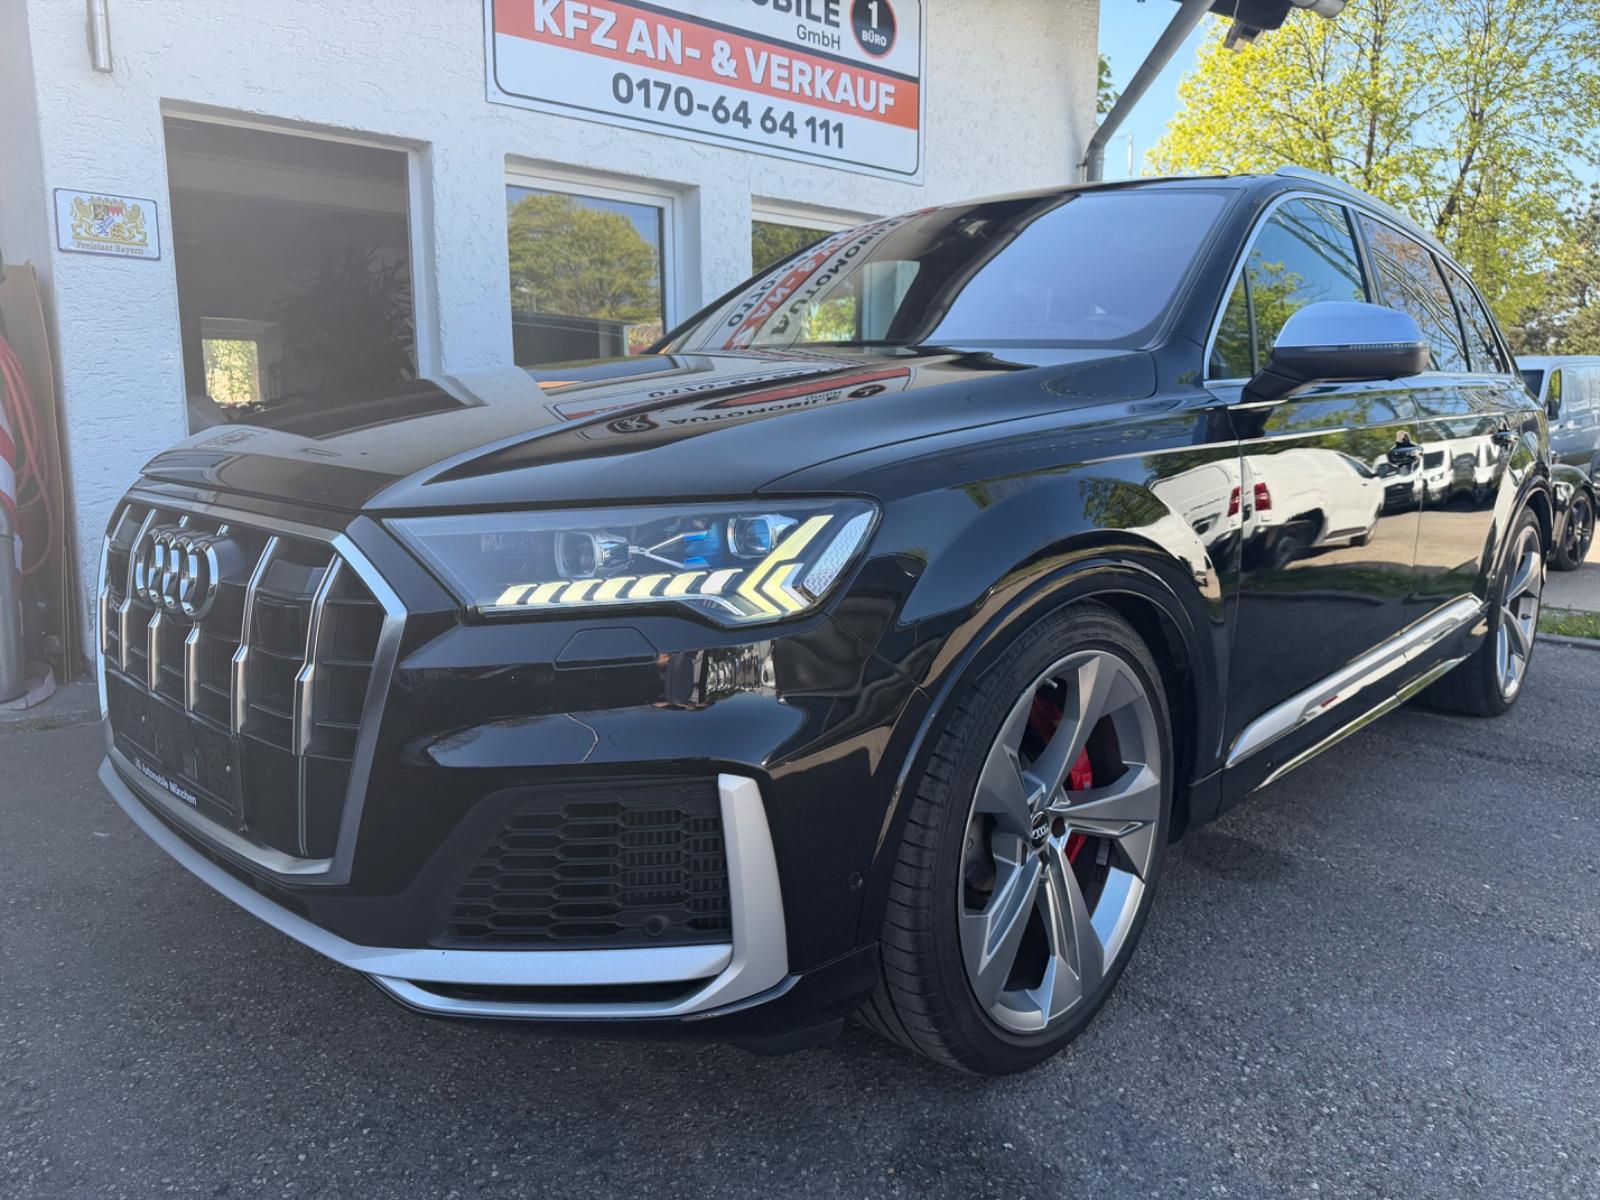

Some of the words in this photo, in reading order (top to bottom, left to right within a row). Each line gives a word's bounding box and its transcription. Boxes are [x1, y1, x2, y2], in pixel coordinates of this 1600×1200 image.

[868, 0, 878, 29] 1
[797, 24, 840, 50] GmbH
[861, 29, 887, 47] BÜRO
[534, 0, 617, 49] KFZ
[626, 18, 701, 66] AN-
[711, 39, 738, 79] &
[744, 46, 896, 114] VERKAUF
[612, 72, 752, 129] 0170-64
[760, 106, 798, 139] 64
[805, 116, 844, 149] 111
[114, 245, 144, 256] Bayern
